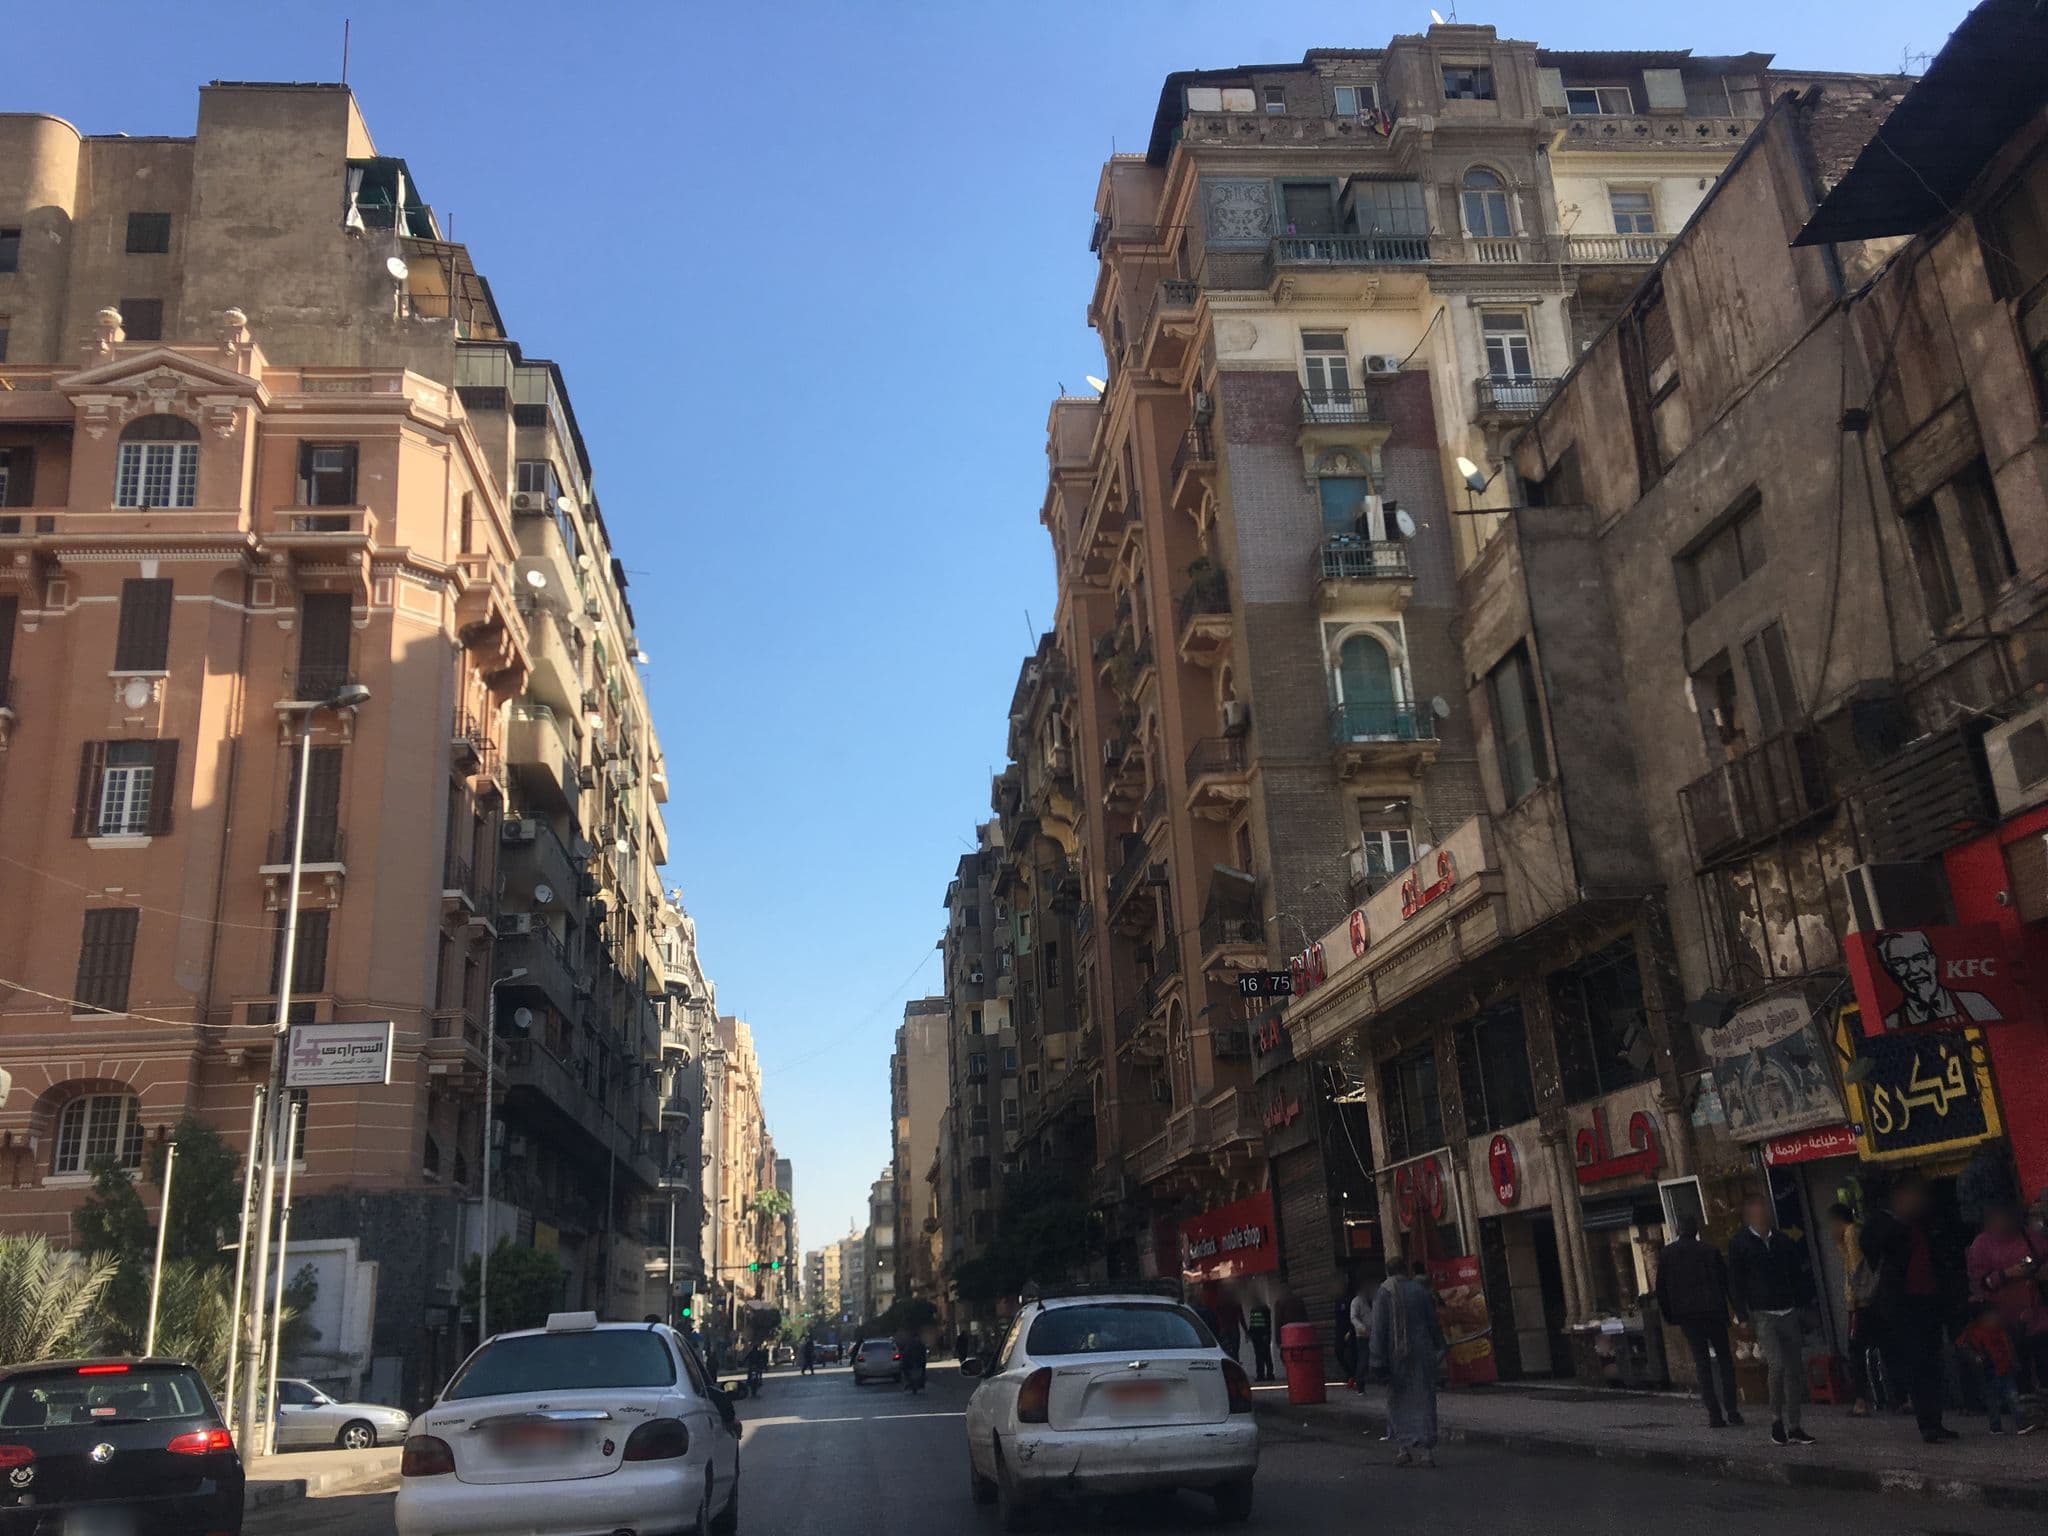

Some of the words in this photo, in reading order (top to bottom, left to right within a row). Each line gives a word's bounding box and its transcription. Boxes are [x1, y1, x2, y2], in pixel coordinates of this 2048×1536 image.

[1946, 958, 1998, 978] KFC
[1239, 977, 1258, 992] 16
[1271, 976, 1290, 991] 75
[1775, 1140, 1801, 1156] ترجمة
[1809, 1132, 1839, 1149] طباعة
